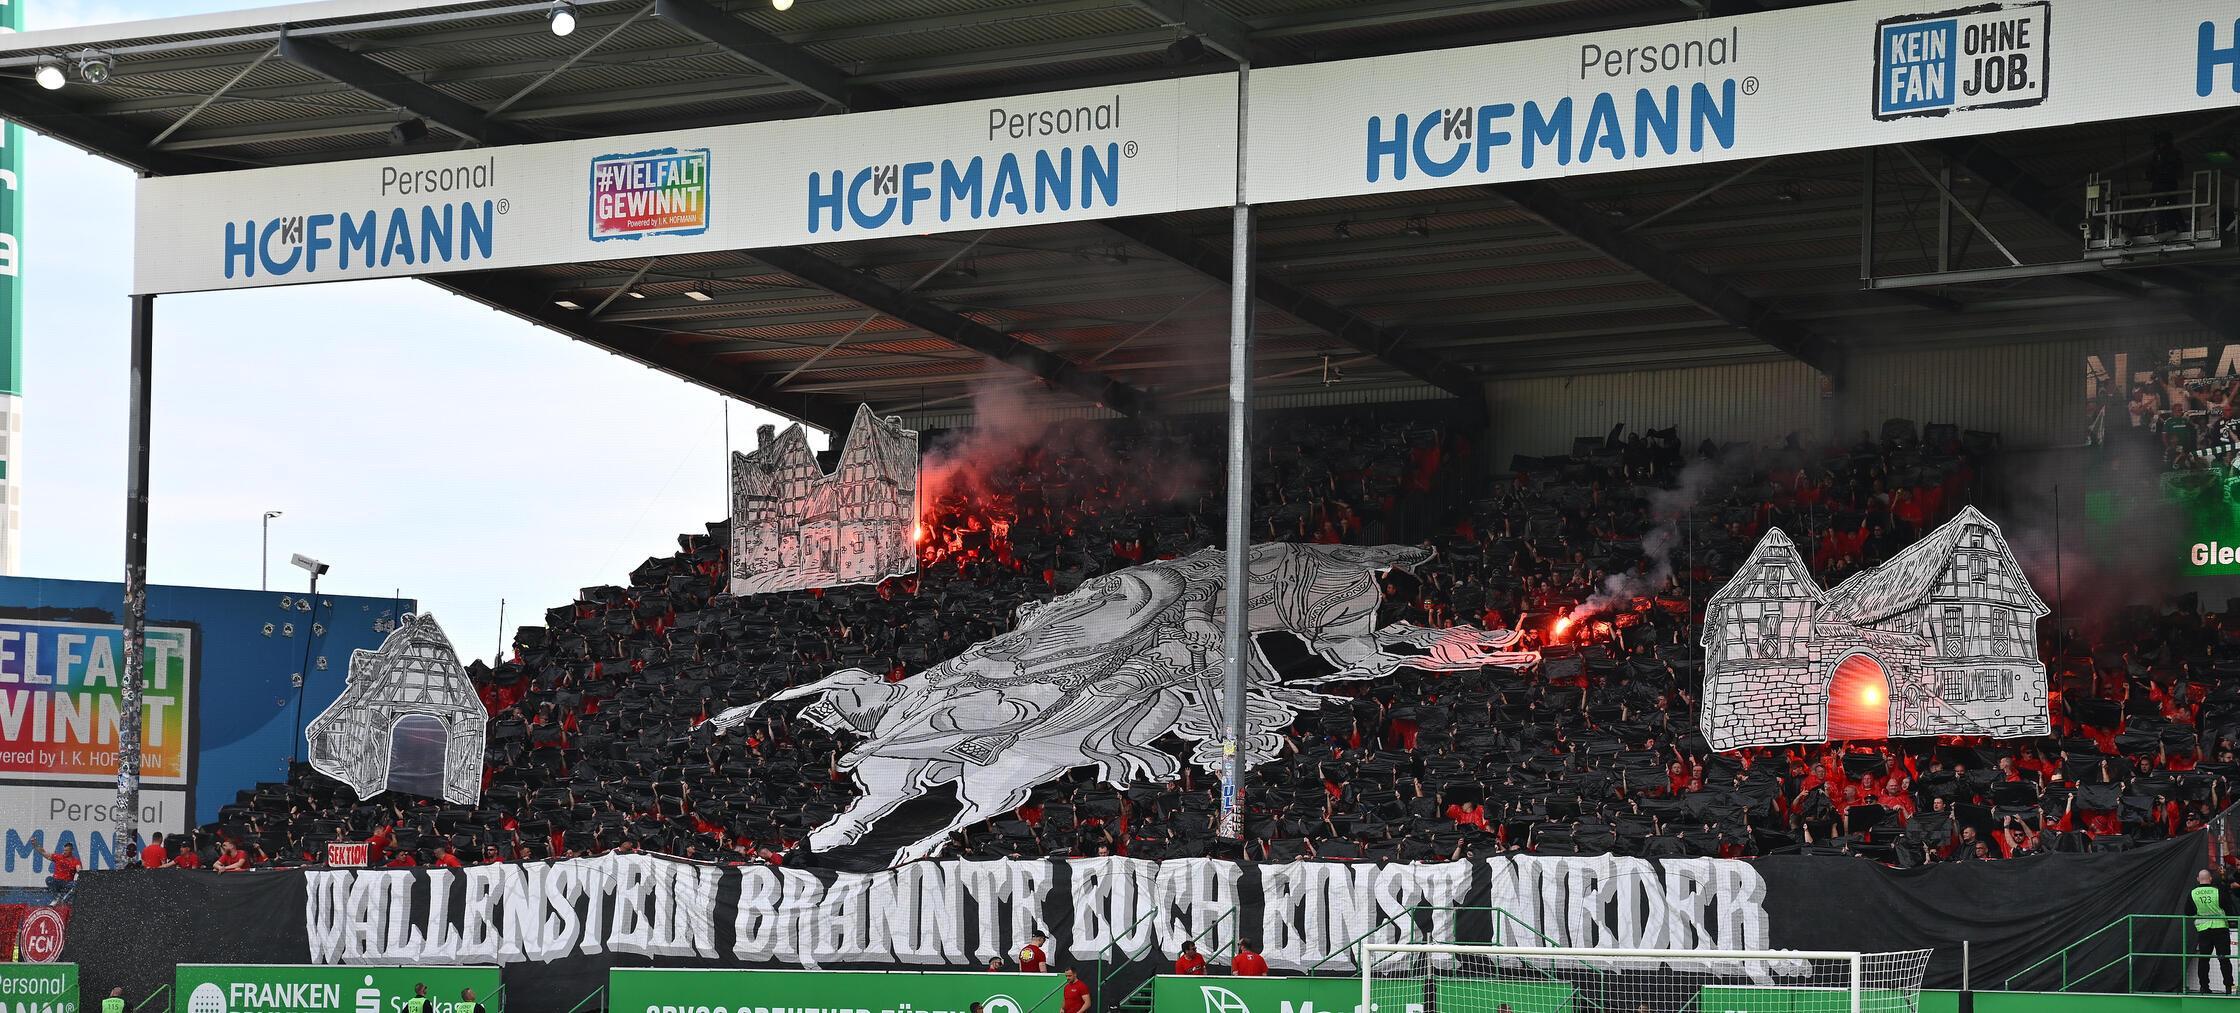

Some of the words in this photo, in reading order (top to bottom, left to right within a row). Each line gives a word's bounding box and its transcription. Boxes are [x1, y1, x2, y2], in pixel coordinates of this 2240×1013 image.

[1580, 26, 1738, 80] Personal
[1891, 28, 1947, 65] KEIN
[1964, 18, 2031, 55] OHNE
[1890, 62, 1945, 104] FAN
[1963, 53, 2036, 96] JOB.
[988, 94, 1120, 141] Personal
[1366, 78, 1736, 183] HOFMANN
[382, 156, 494, 196] Personal
[598, 158, 703, 192] #VIELFALT
[808, 142, 1119, 233] HOFMANN
[599, 185, 701, 219] GEWINNT
[627, 218, 650, 228] Powered
[651, 217, 657, 227] by
[669, 214, 697, 224] HOFMANN
[224, 199, 493, 279] HOFMANN
[0, 631, 178, 689] ELFAT
[39, 751, 56, 768] by
[89, 752, 162, 769] HOFNN
[329, 845, 368, 865] SEKTION
[304, 852, 724, 965] WALLENSTEIN
[732, 856, 1057, 970] BRANNTE
[1069, 855, 1243, 968] EUCH
[1258, 857, 1473, 976] EINST
[28, 935, 54, 953] FCN
[0, 973, 65, 994] ersonal
[229, 983, 340, 1009] FRANKEN
